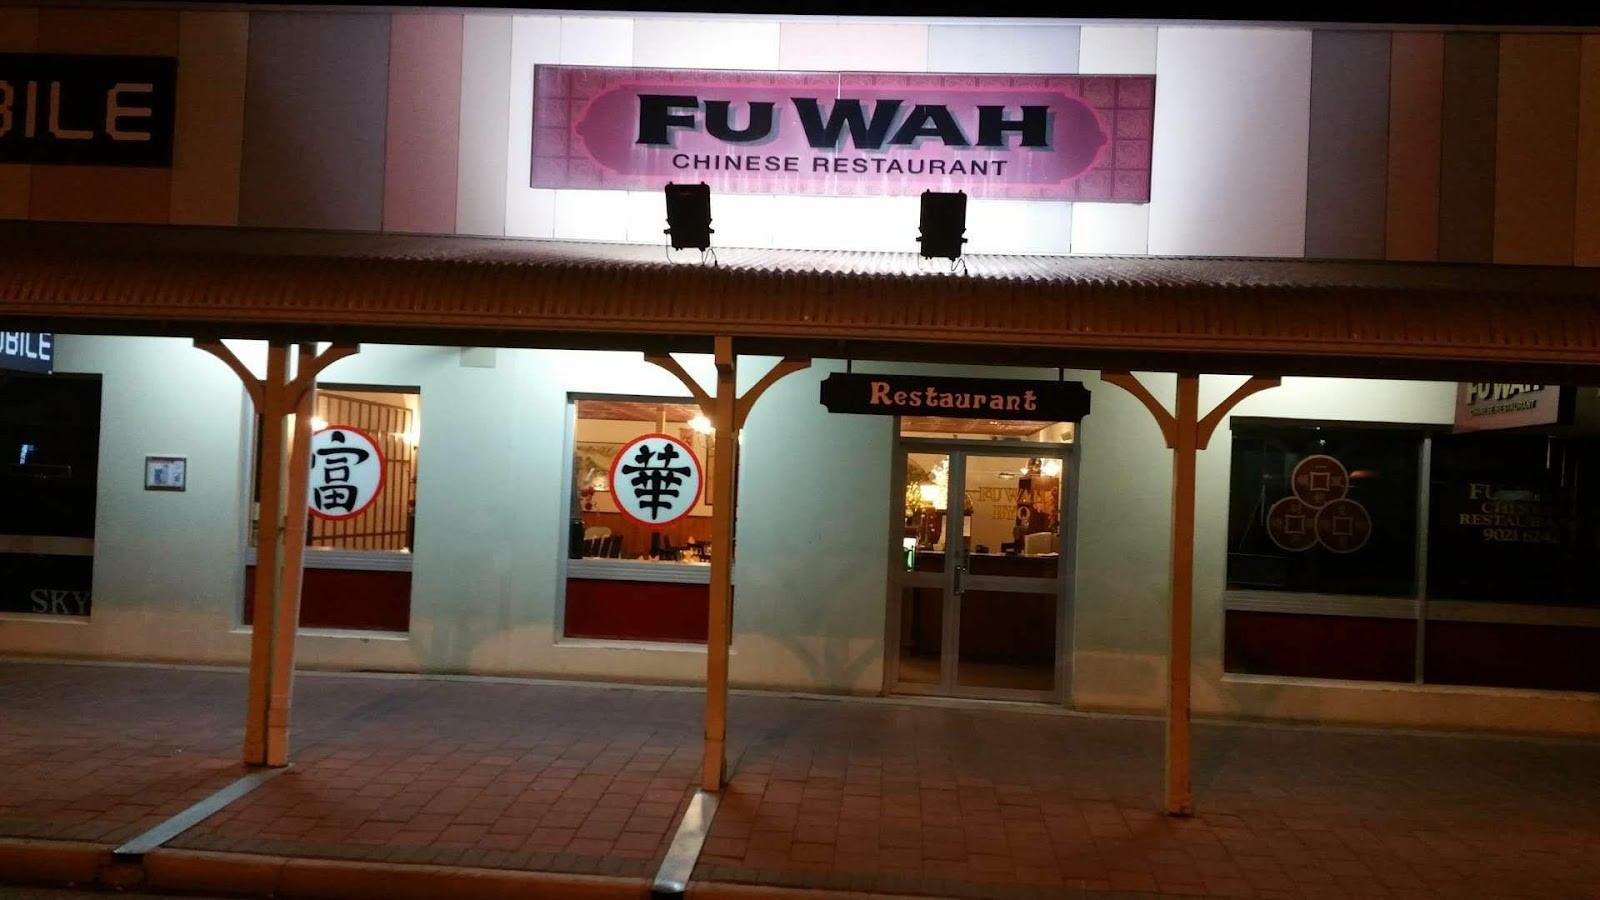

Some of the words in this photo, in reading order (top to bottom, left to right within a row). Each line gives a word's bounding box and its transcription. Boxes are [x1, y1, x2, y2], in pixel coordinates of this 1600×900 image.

[635, 94, 777, 144] FU
[790, 97, 1050, 150] WAH
[672, 153, 799, 172] CHINESE
[812, 157, 1008, 176] RESTAURANT
[869, 381, 1037, 411] Restaurant
[311, 431, 369, 512] 富
[622, 443, 691, 520] 華
[30, 588, 90, 614] SKY
